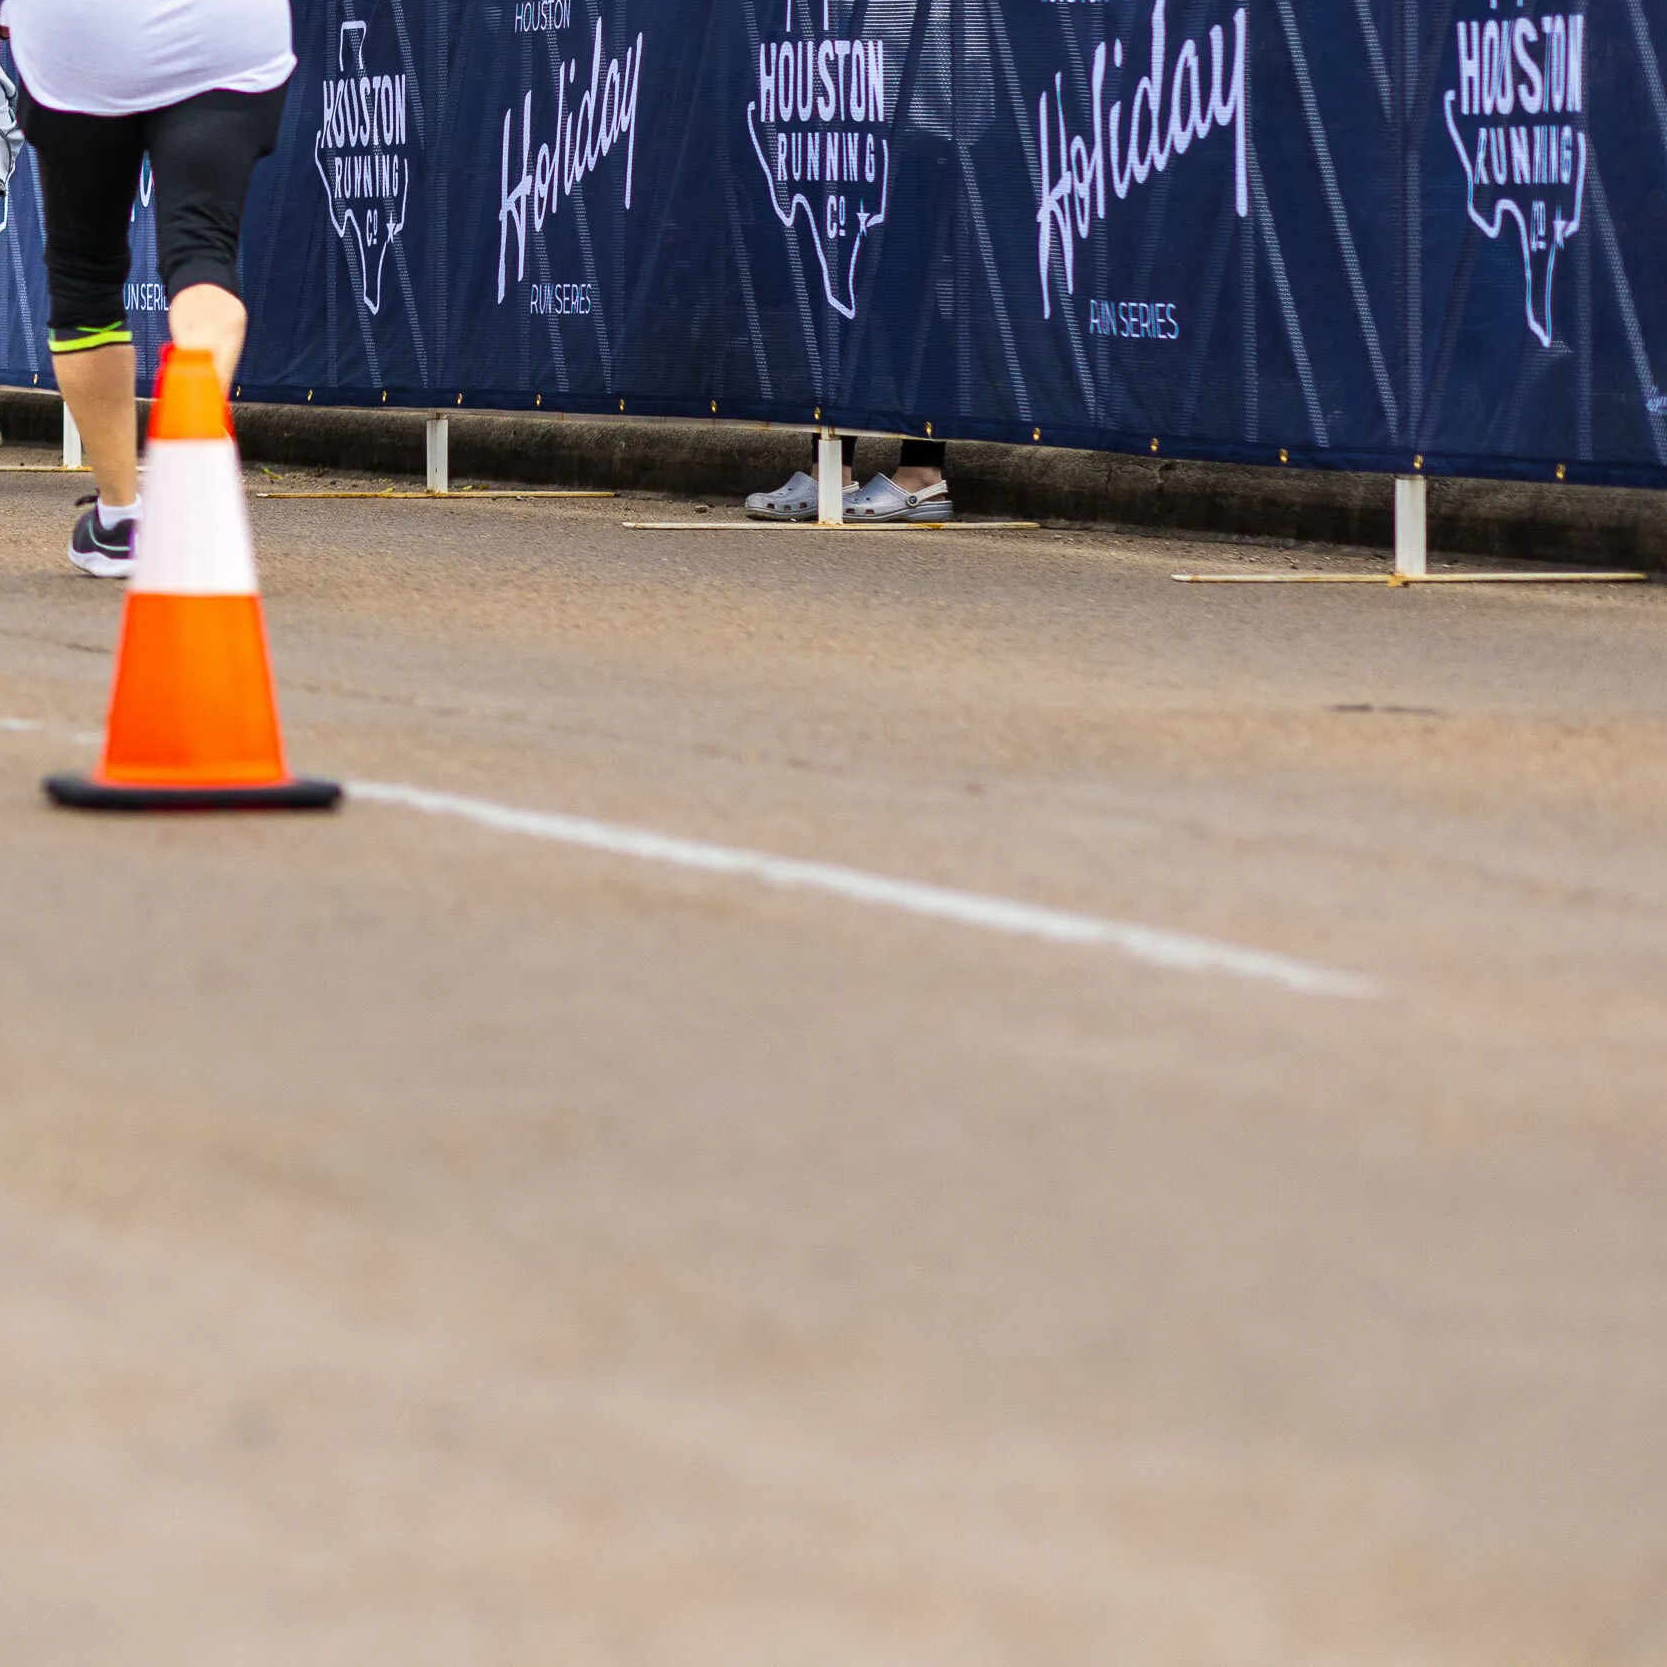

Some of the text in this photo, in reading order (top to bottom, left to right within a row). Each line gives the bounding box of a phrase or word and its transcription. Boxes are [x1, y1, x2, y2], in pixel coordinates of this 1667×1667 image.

[759, 40, 884, 122] HOUSTON
[1457, 14, 1584, 115] HOUSTON
[321, 74, 406, 148] HOUSTON
[334, 154, 398, 198] RUNNING
[497, 16, 643, 304] Holiday
[777, 132, 876, 183] RUNNING
[124, 283, 169, 311] UN SERIE
[530, 284, 592, 314] RUN SERIES
[1118, 302, 1179, 339] SERIES
